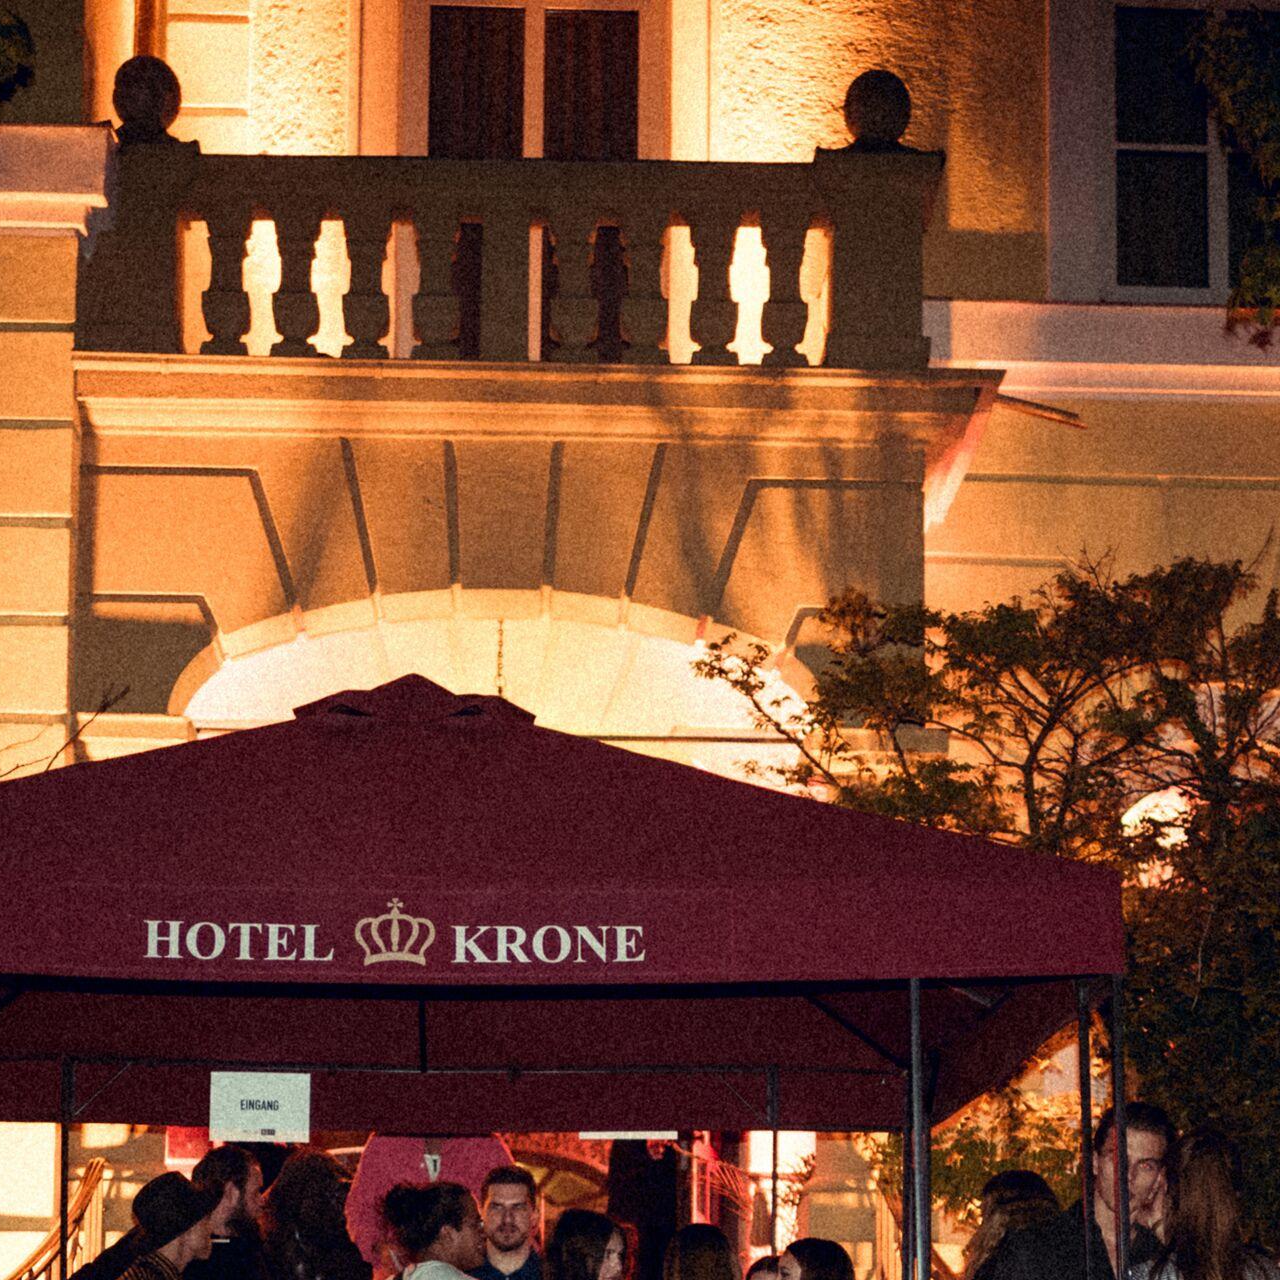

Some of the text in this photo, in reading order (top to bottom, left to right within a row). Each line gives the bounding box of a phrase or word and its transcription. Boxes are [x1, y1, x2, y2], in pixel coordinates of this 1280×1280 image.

[143, 919, 646, 963] HOTEL KRONE
[239, 1099, 280, 1111] EINGANG
